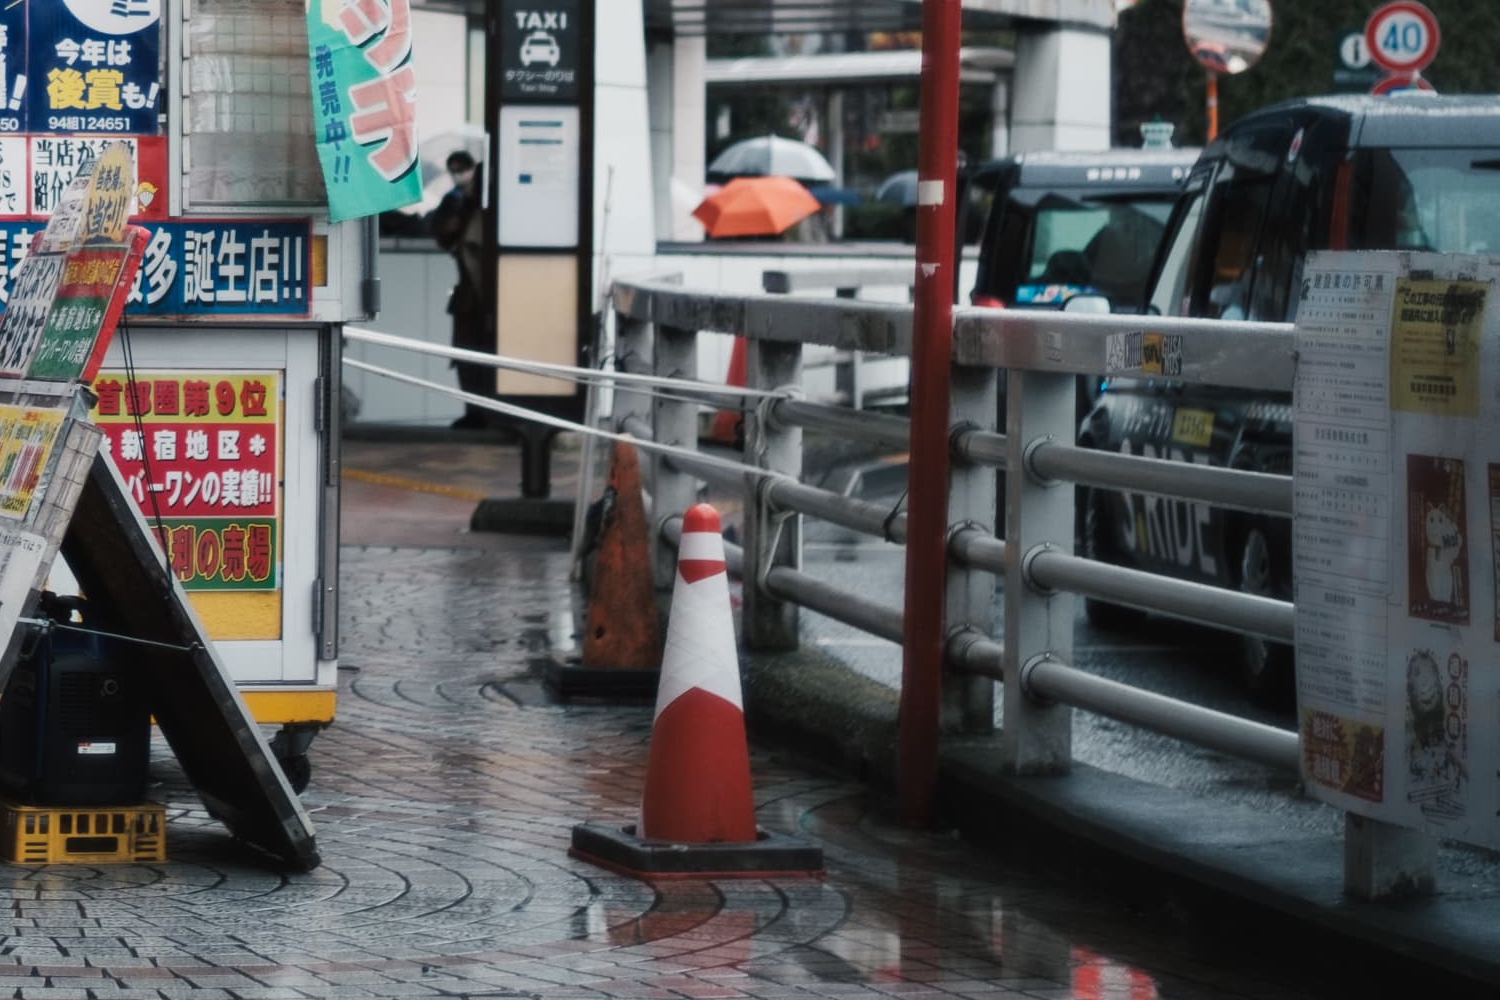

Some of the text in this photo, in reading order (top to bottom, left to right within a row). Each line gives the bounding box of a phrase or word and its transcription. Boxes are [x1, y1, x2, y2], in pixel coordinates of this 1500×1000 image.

[515, 11, 567, 30] TAXI
[55, 38, 132, 66] 今年は
[1382, 22, 1422, 54] 40
[47, 67, 160, 110] 後賞も!
[48, 116, 131, 131] 94組124651
[95, 379, 267, 417] 首都圏第9位
[128, 468, 272, 507] バーワンの実績!!
